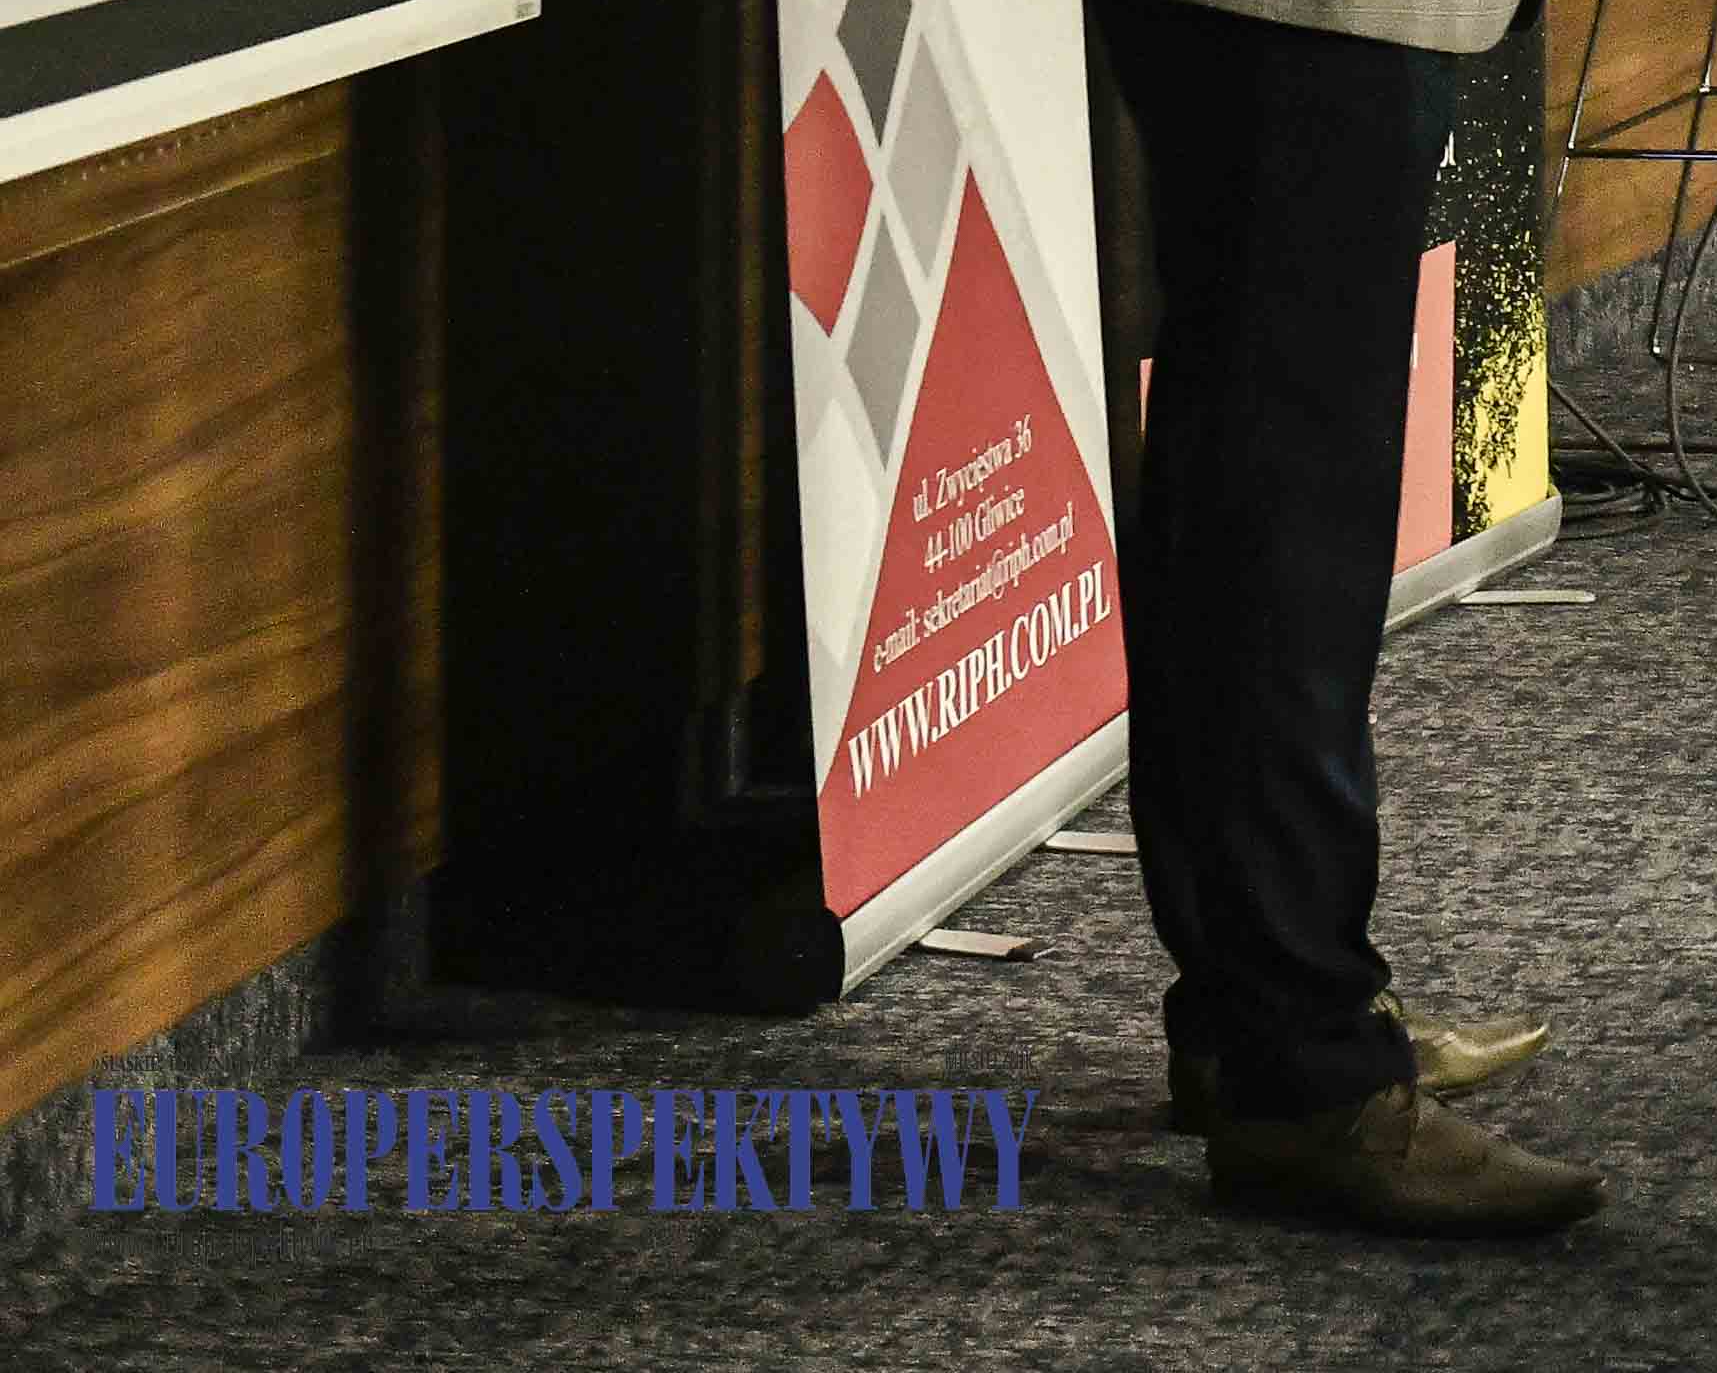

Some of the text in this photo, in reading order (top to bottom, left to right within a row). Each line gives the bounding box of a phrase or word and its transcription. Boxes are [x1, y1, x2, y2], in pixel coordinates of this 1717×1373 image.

[912, 475, 932, 522] ul.
[1013, 413, 1032, 461] 36
[924, 485, 1025, 573] 44-100 Gliwice
[848, 561, 1111, 799] WWW.RIPH.COM.PL
[873, 608, 922, 673] e-mail:
